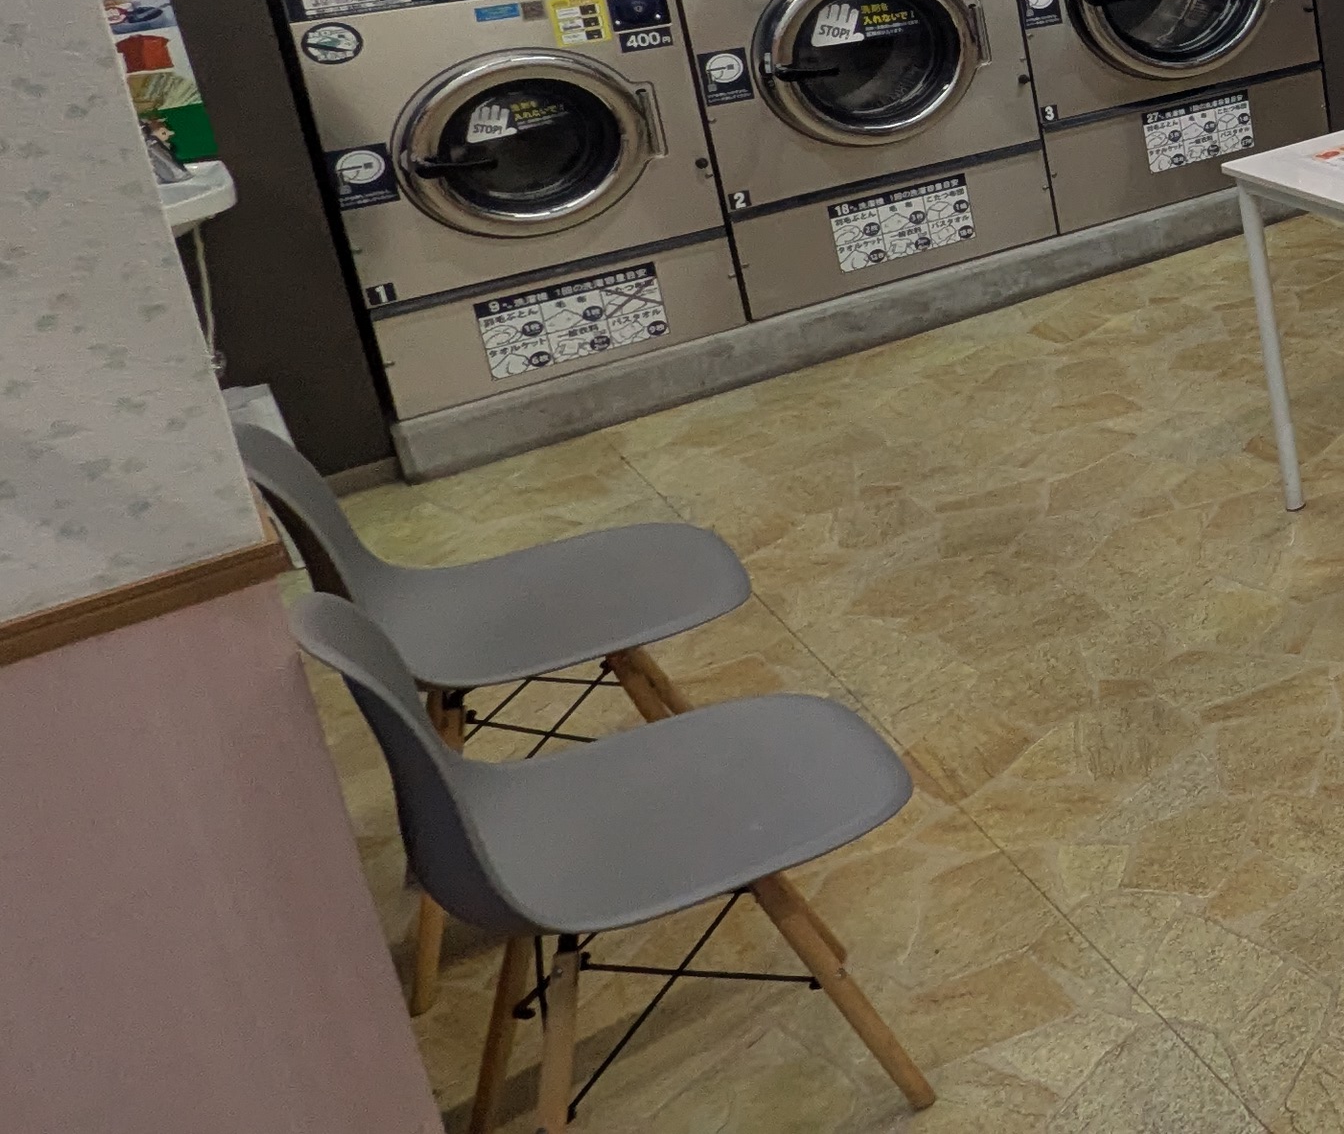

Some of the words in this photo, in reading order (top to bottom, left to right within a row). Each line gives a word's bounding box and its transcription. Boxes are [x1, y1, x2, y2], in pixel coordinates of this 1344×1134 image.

[626, 32, 671, 47] 400円
[819, 24, 850, 40] STOP!
[1044, 105, 1056, 120] 3
[473, 124, 503, 135] STOP!
[734, 193, 748, 208] 2
[931, 215, 970, 229] バスタオル
[375, 285, 386, 302] 1
[612, 309, 661, 327] バスタオル
[489, 338, 547, 358] タオルケット
